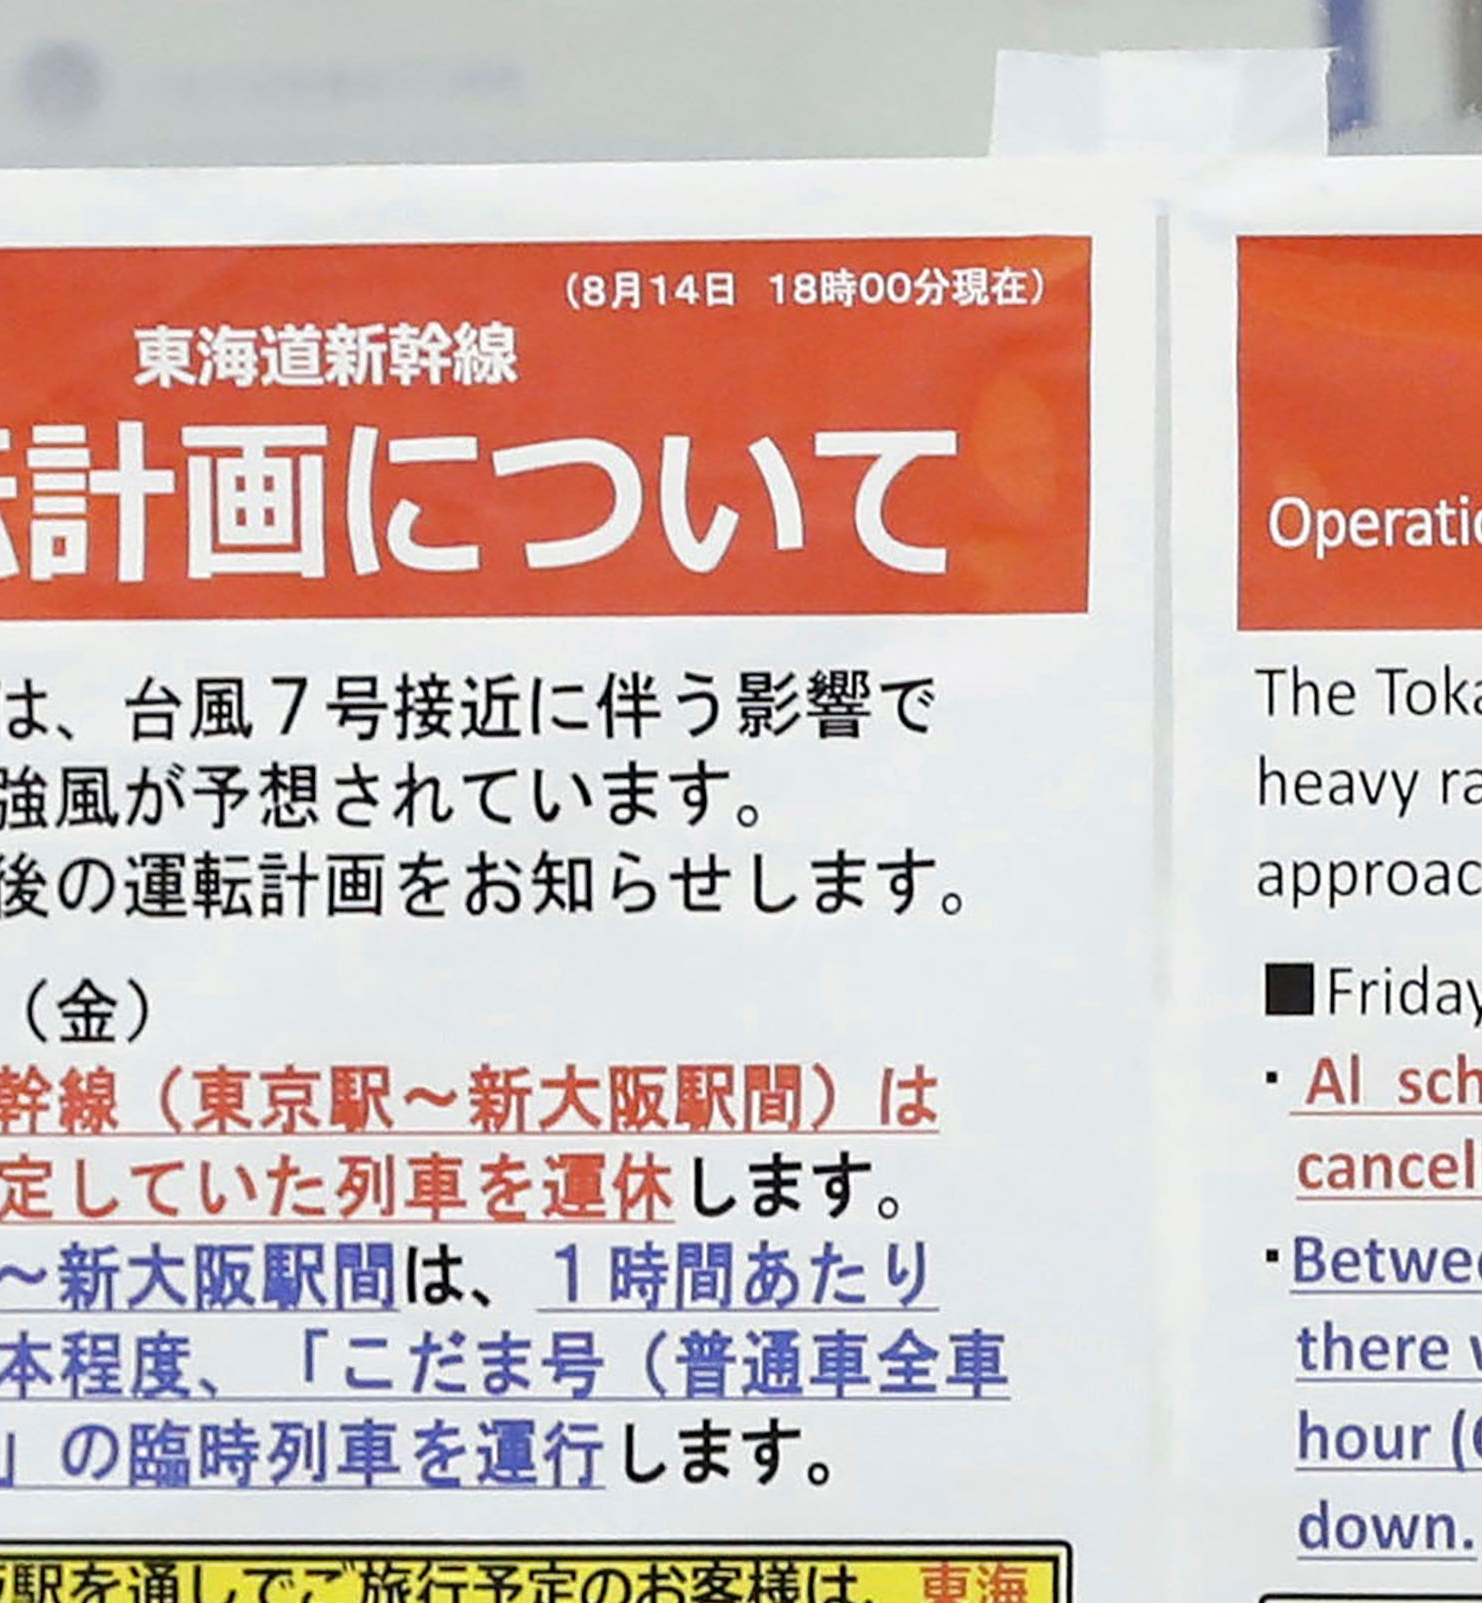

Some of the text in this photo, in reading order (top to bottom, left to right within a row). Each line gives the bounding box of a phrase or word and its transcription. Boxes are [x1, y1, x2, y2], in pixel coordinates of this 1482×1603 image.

[567, 266, 1043, 309] （8月14日 18時00分現在）
[133, 321, 519, 391] 東海道新幹線
[1255, 665, 1355, 716] The
[1306, 1054, 1359, 1104] Al
[1300, 1410, 1431, 1460] hour
[1299, 1499, 1473, 1549] down.
